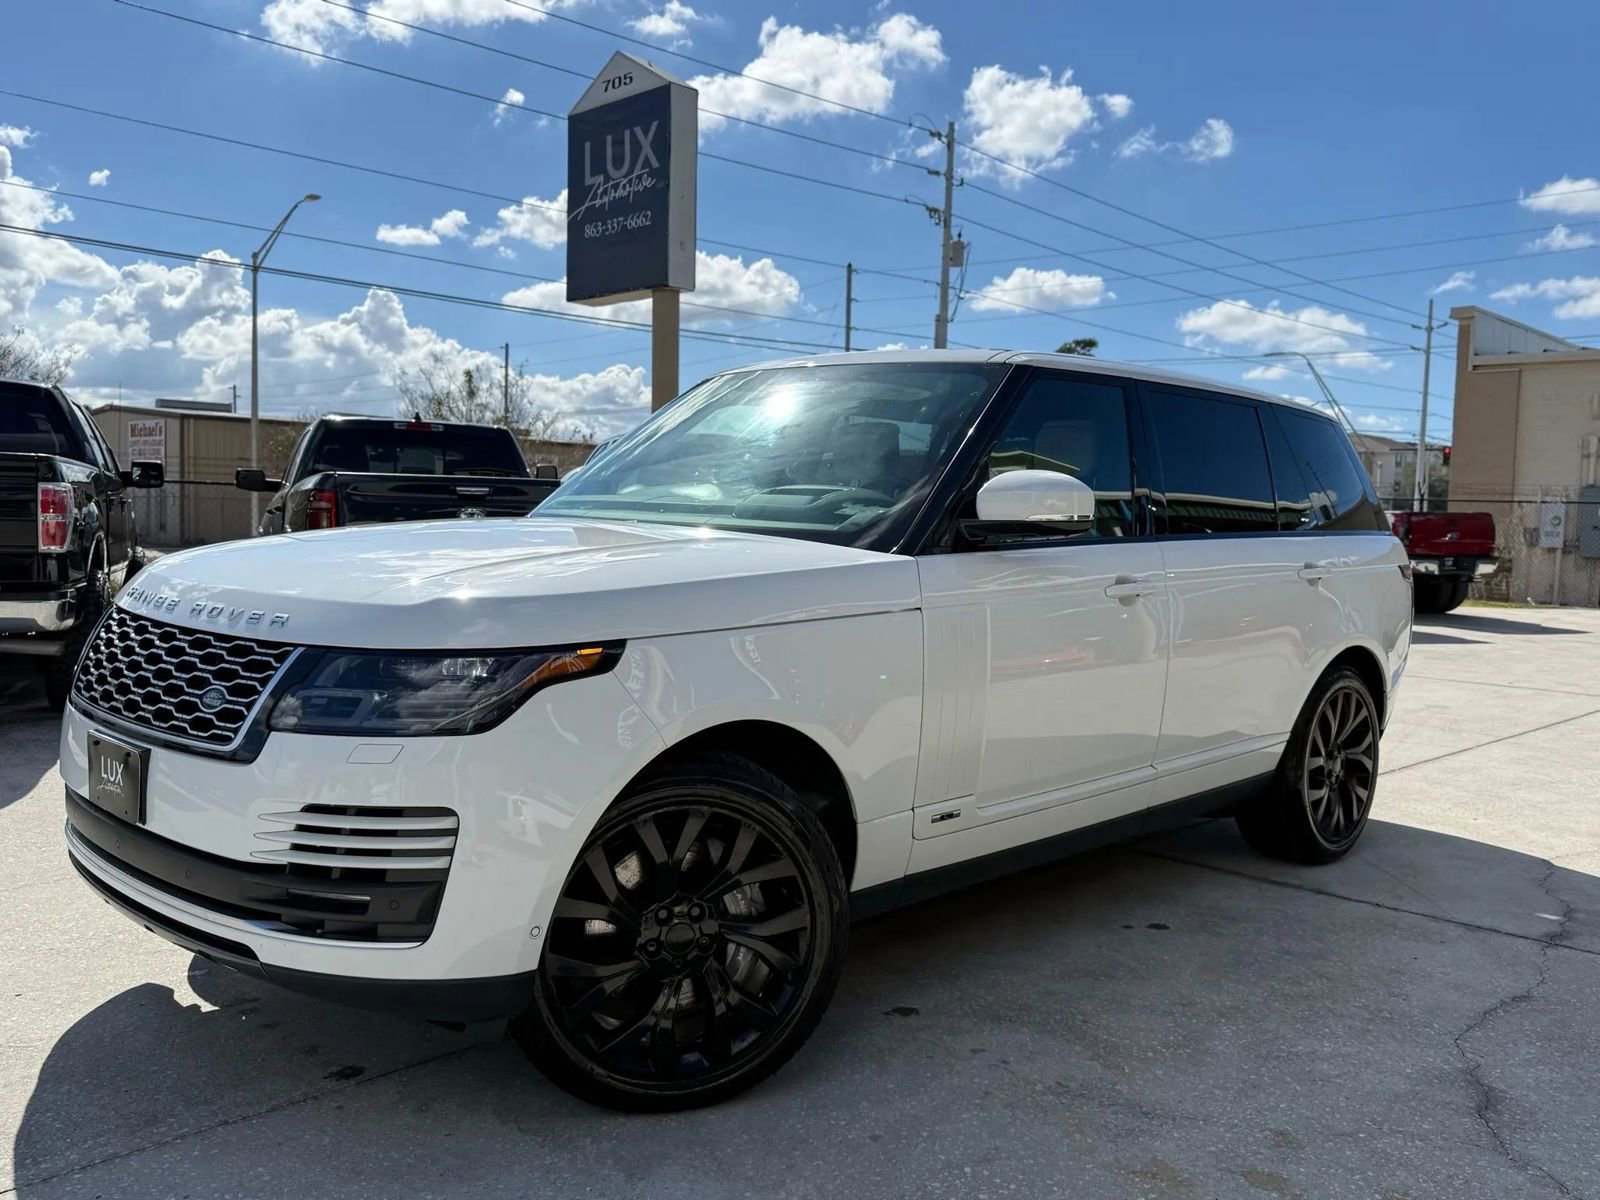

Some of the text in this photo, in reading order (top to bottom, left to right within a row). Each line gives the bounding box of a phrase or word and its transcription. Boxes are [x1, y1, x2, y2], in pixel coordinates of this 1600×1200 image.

[602, 72, 634, 93] 705
[584, 120, 660, 187] LUX
[568, 169, 656, 221] Automotive
[584, 210, 652, 238] 863-337-6662
[127, 586, 290, 628] RANGE ROVER
[101, 755, 124, 786] LUX
